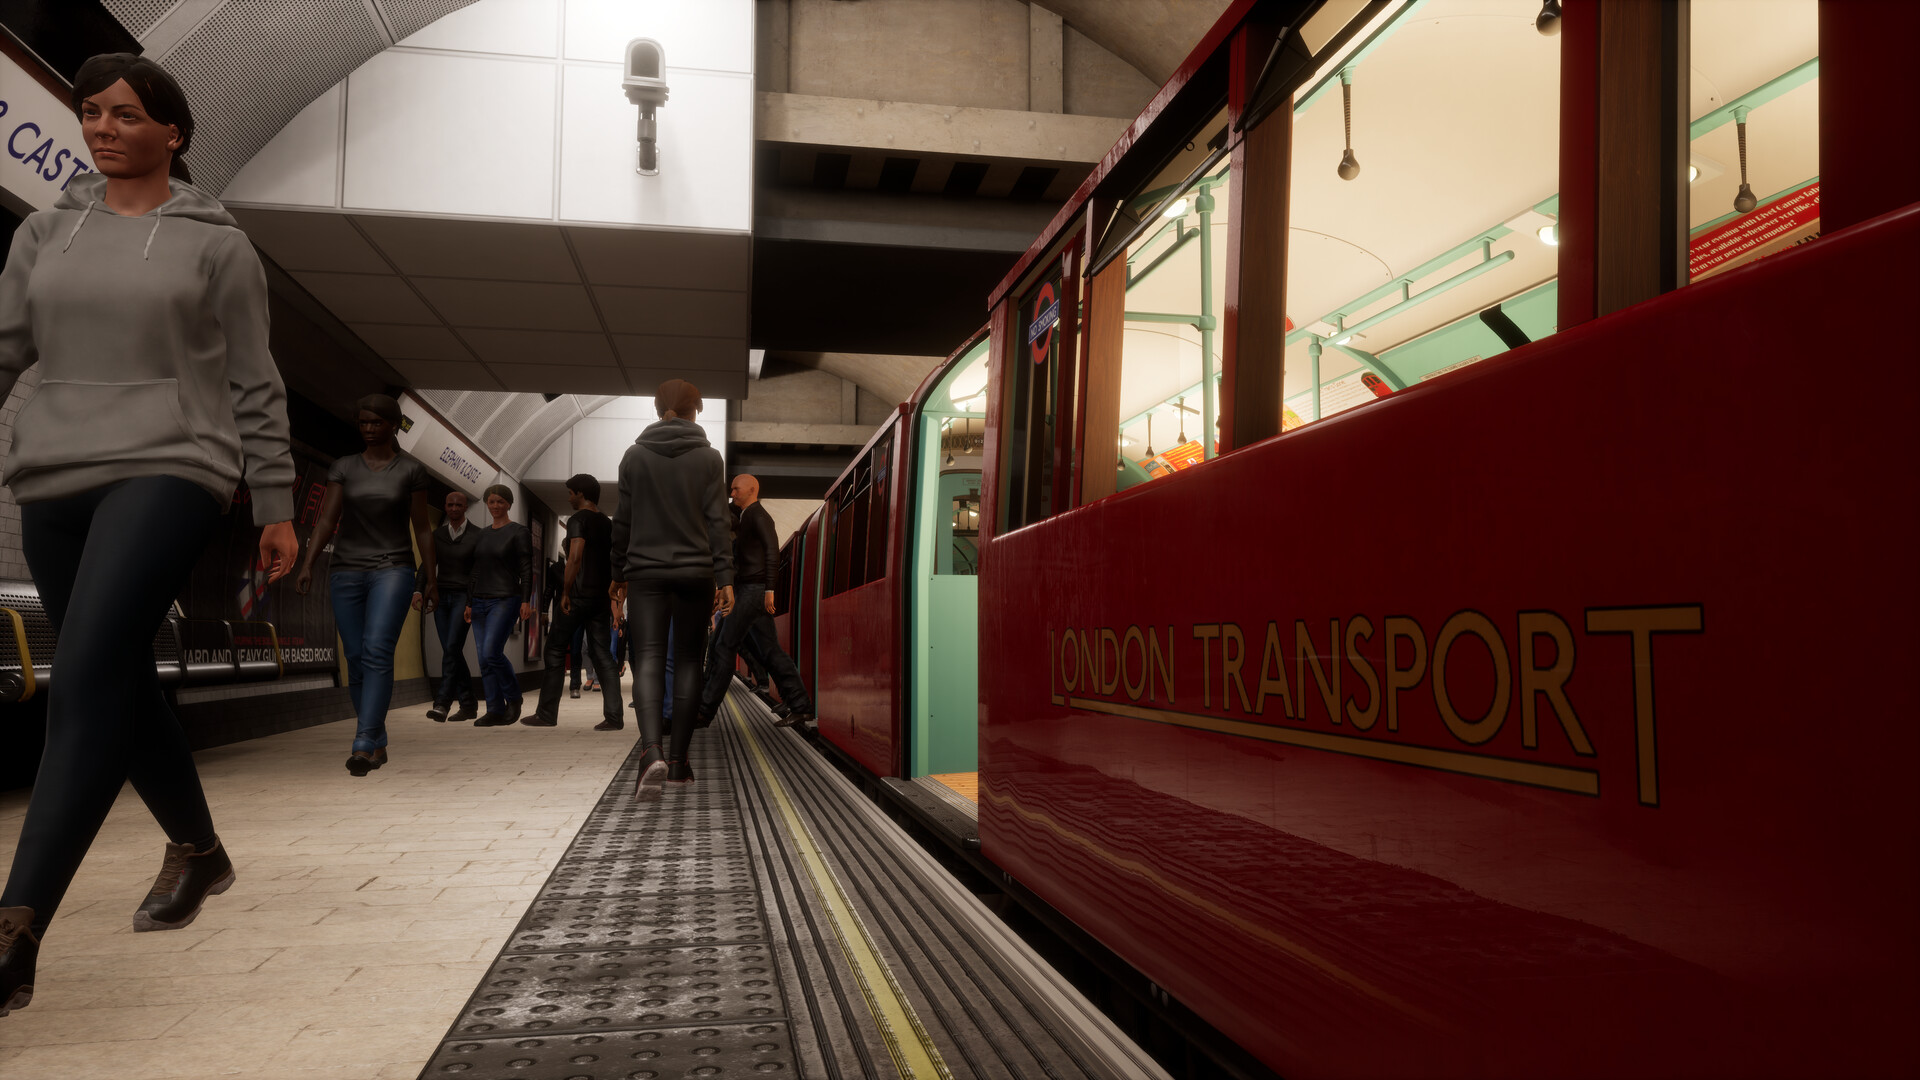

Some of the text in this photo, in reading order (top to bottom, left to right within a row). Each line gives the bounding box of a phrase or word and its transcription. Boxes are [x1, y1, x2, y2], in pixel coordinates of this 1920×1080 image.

[8, 122, 94, 192] CAST
[1695, 242, 1711, 254] your
[1711, 228, 1740, 244] evening
[1739, 217, 1757, 230] with
[1775, 194, 1804, 212] Games
[1707, 255, 1724, 267] your
[1724, 239, 1756, 259] personal
[1755, 219, 1797, 244] computer!
[1710, 235, 1742, 254] available
[1740, 218, 1780, 240] whenever
[1779, 211, 1794, 223] you
[1792, 200, 1814, 214] like,
[1038, 306, 1057, 332] SMOKING
[439, 446, 466, 471] ELEPHANT
[463, 464, 482, 484] CASTLE
[211, 648, 232, 663] AND
[291, 647, 314, 664] BASED
[314, 646, 334, 663] ROCK!
[1051, 603, 1704, 809] LONDON TRANSPORT
